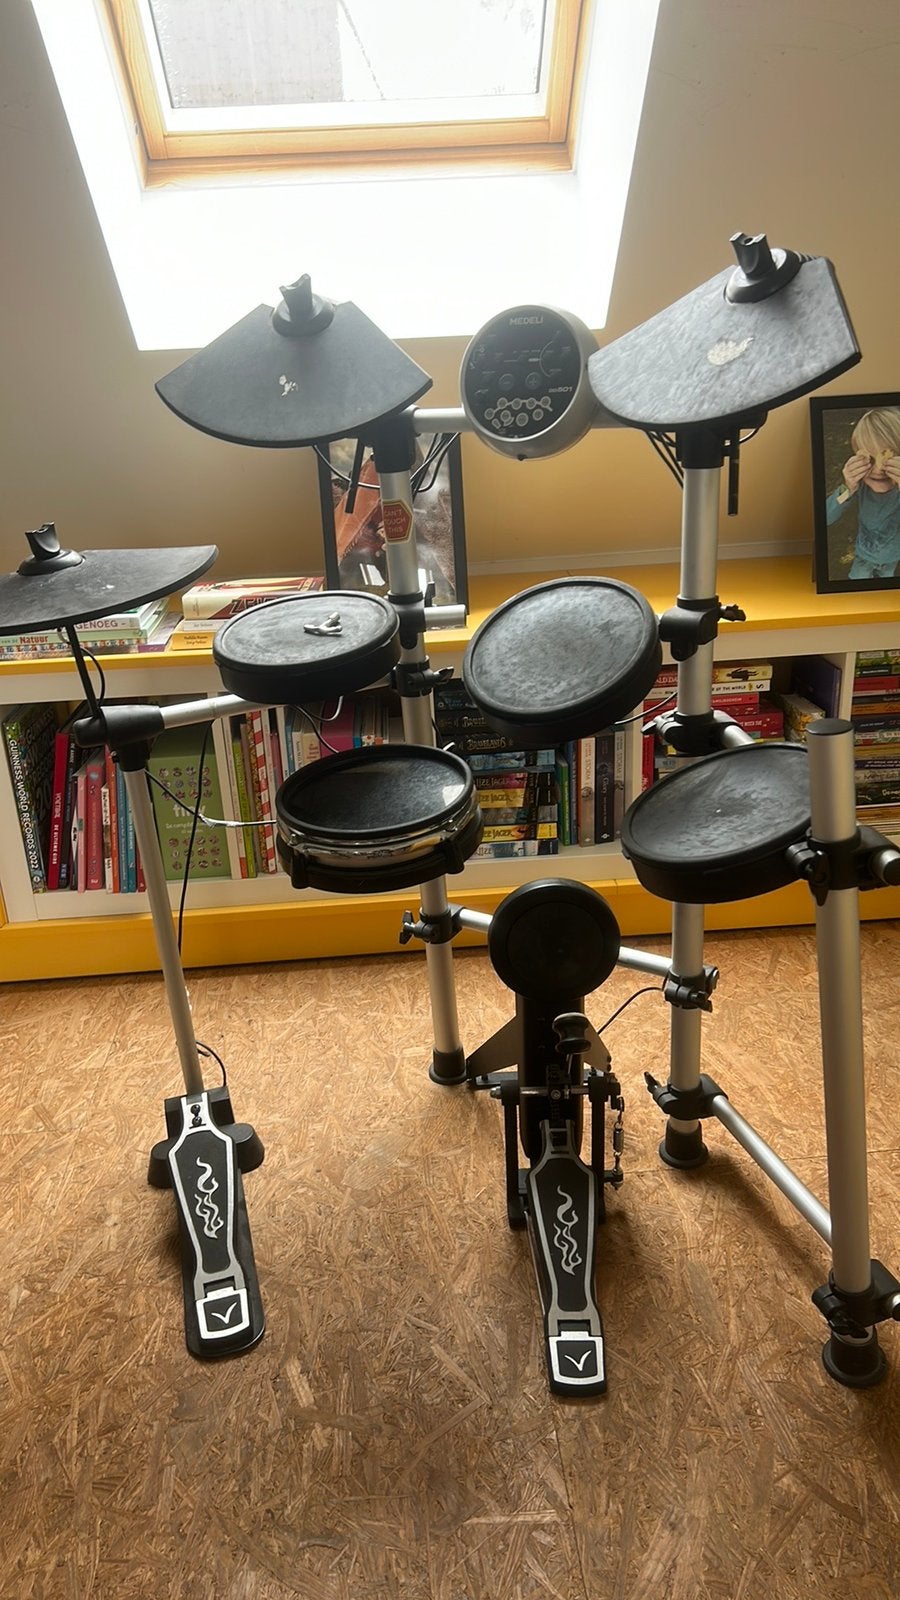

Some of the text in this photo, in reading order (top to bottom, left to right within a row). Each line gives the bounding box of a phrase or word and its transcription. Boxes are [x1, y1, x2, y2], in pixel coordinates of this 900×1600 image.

[509, 316, 543, 325] MEDELI
[76, 618, 118, 630] GENOEG
[20, 636, 48, 644] Natuur
[490, 794, 512, 803] JAGER
[9, 740, 39, 869] GUINNESS WORLD RECORDS 2022
[493, 829, 514, 840] JAGER
